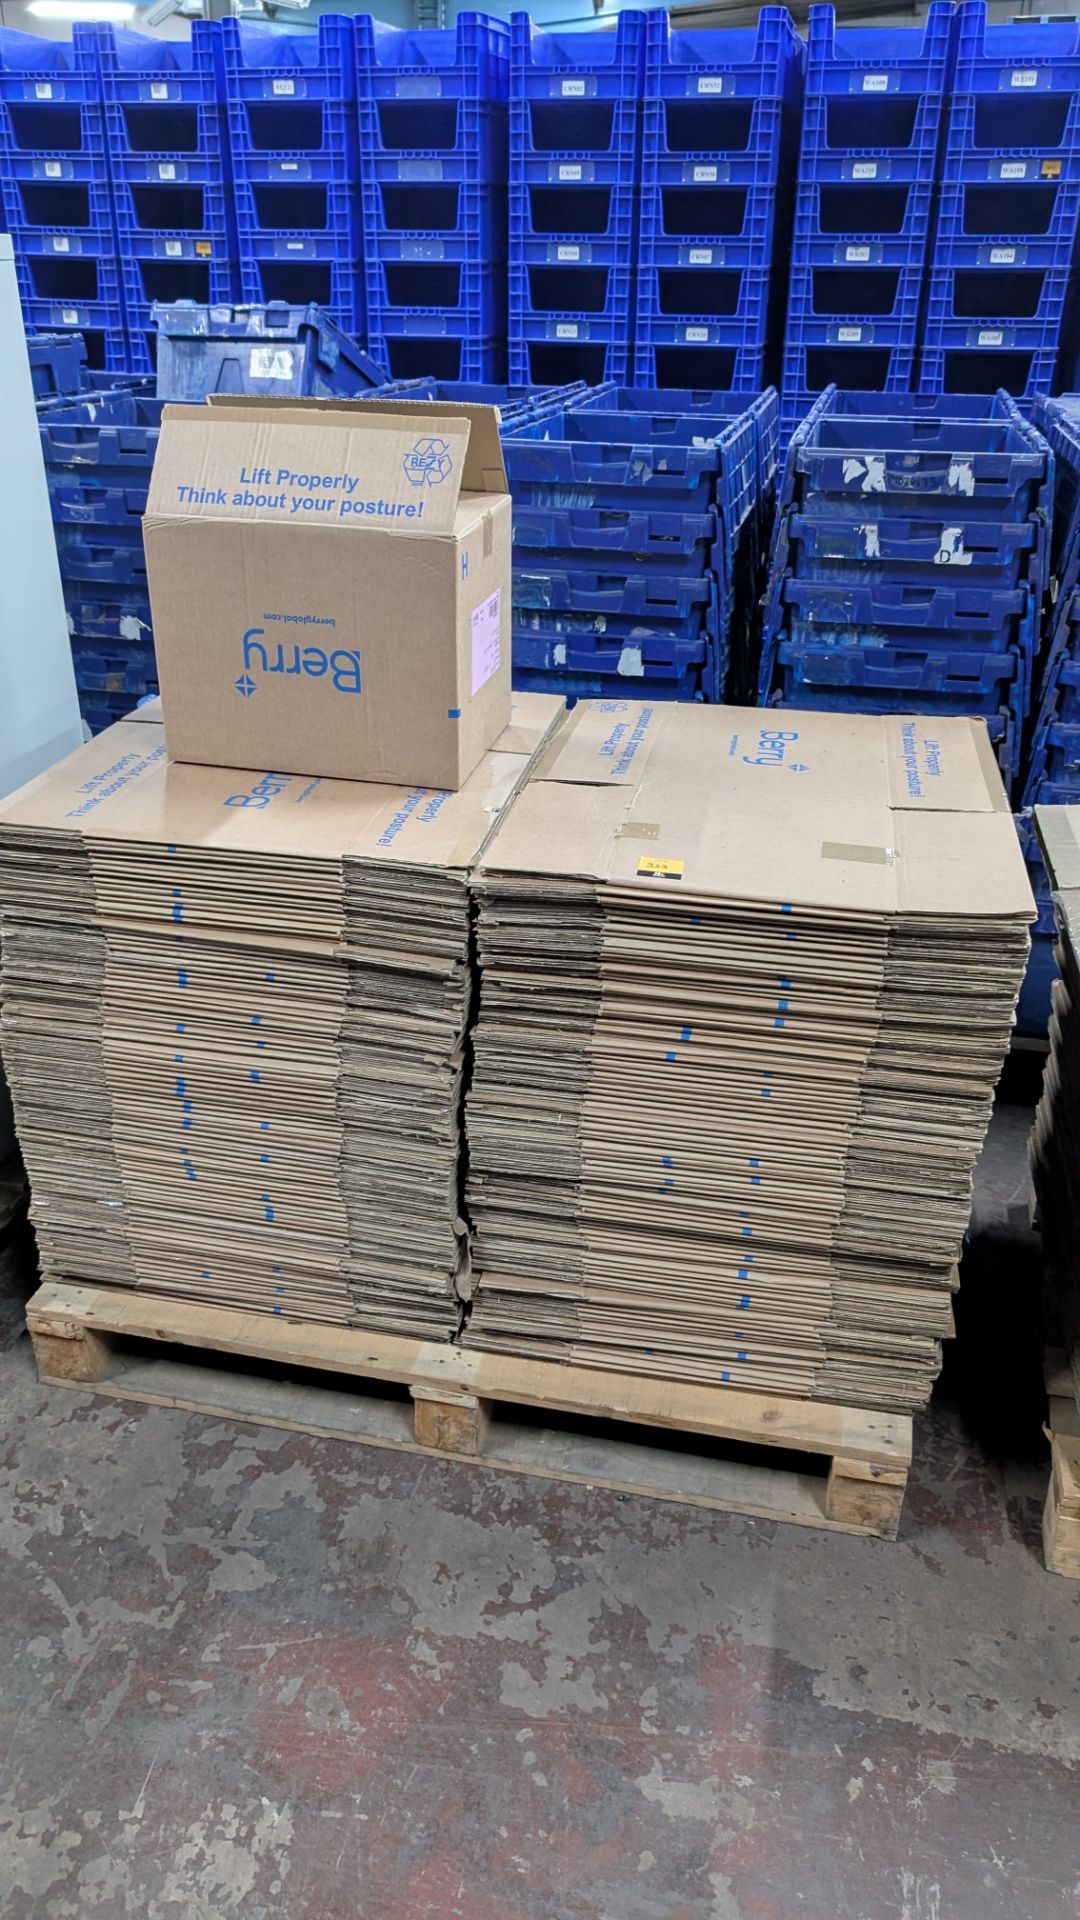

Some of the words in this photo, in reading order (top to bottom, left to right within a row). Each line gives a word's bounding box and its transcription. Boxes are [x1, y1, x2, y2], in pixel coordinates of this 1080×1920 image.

[240, 467, 271, 485] Lift
[276, 470, 360, 493] Properly
[177, 486, 227, 505] Think
[232, 490, 287, 509] about
[290, 497, 336, 513] your
[339, 500, 424, 518] posture!
[940, 550, 952, 564] D
[264, 613, 336, 627] berryglobal.com
[243, 628, 362, 694] Berry
[902, 722, 916, 736] Think
[743, 730, 799, 766] Berry
[92, 753, 142, 780] Properly
[901, 755, 918, 769] your
[923, 752, 944, 776] Properly
[65, 798, 104, 818] Think
[99, 778, 131, 796] about
[125, 761, 150, 776] your
[223, 772, 292, 810] Berr
[904, 770, 926, 798] posture!
[402, 795, 424, 813] your
[376, 812, 410, 848] posture!
